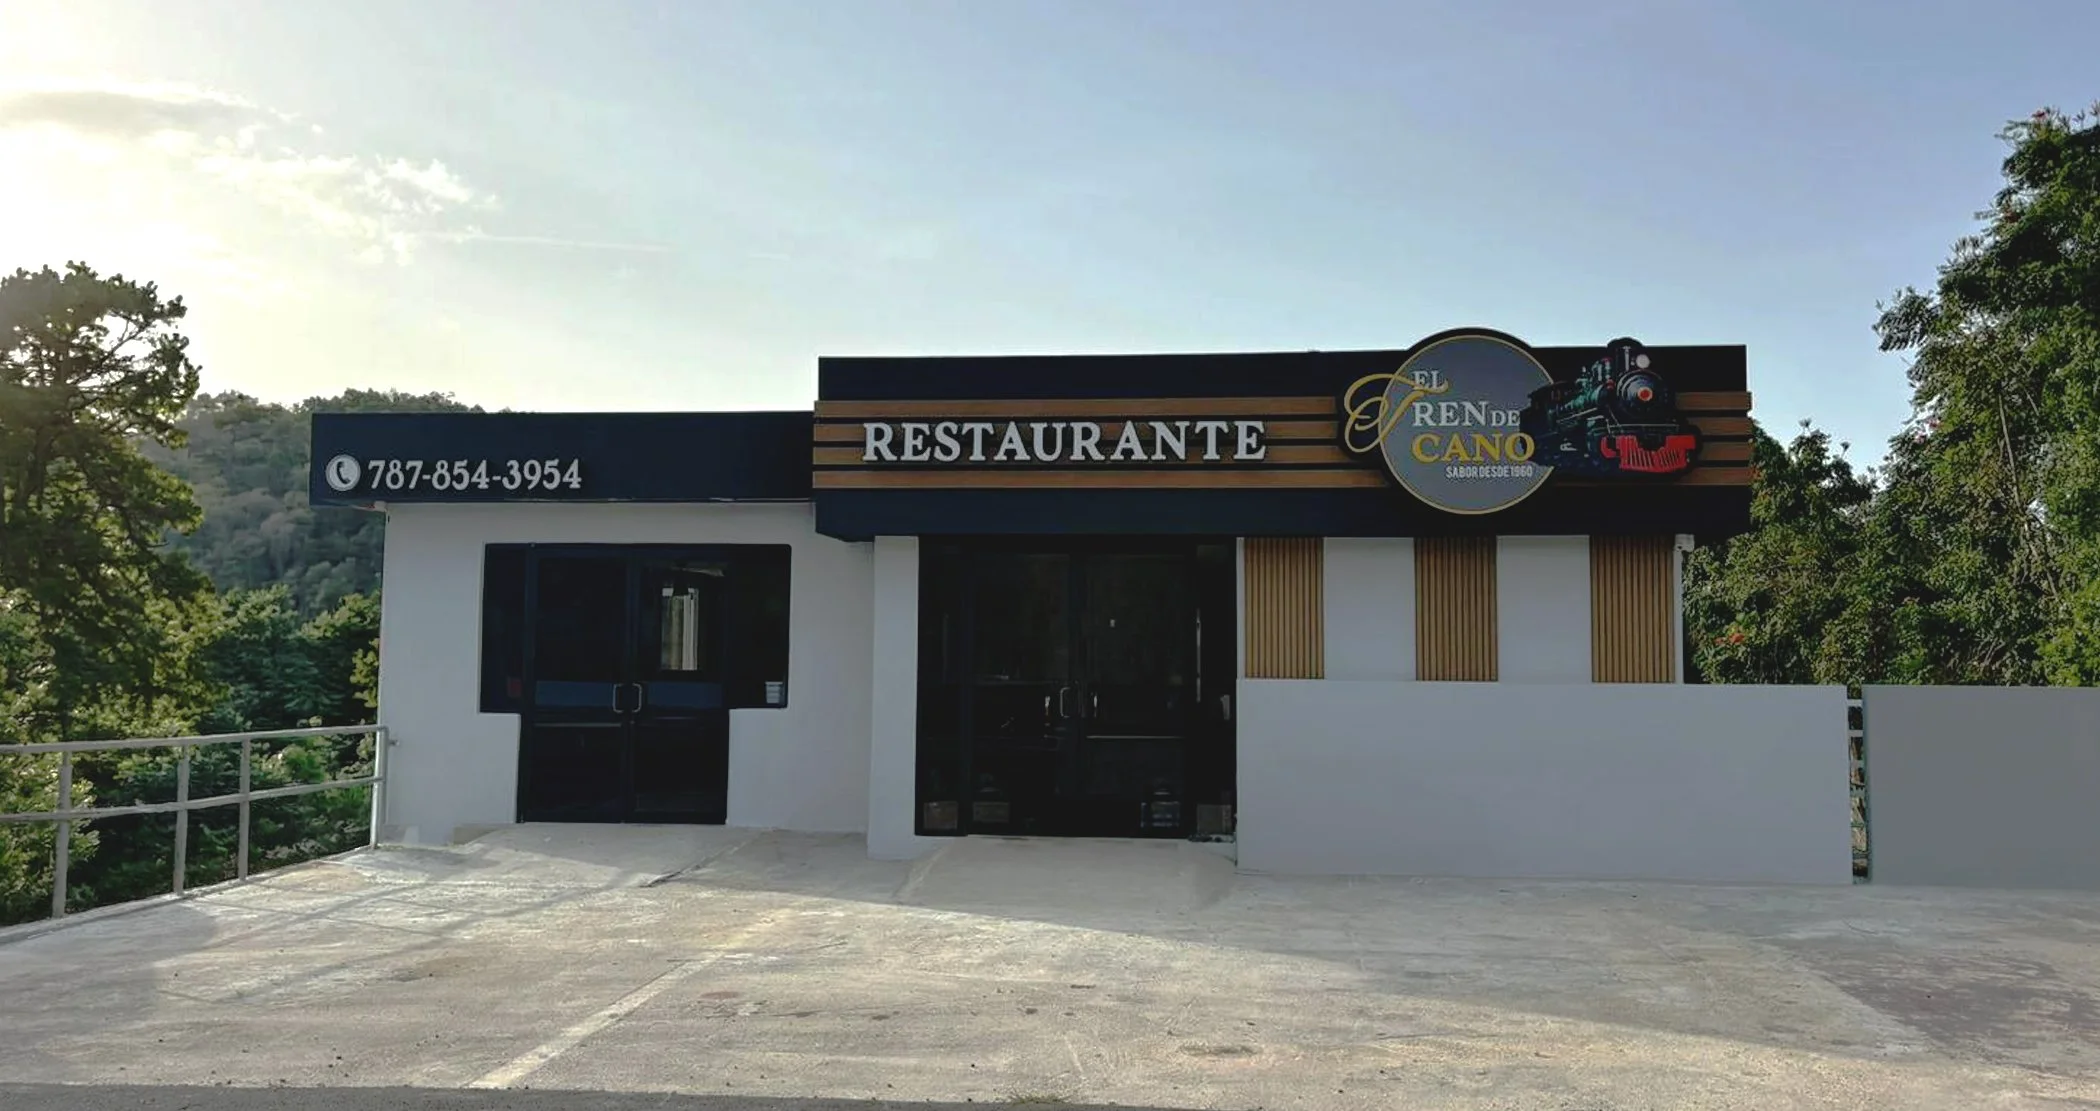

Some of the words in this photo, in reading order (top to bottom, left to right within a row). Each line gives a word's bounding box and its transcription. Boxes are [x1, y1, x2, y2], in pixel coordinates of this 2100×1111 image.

[1412, 370, 1442, 390] EL
[1491, 409, 1521, 426] DE
[862, 420, 1267, 462] RESTAURANTE
[1411, 431, 1535, 463] CANO
[367, 458, 582, 490] 787-854-3954
